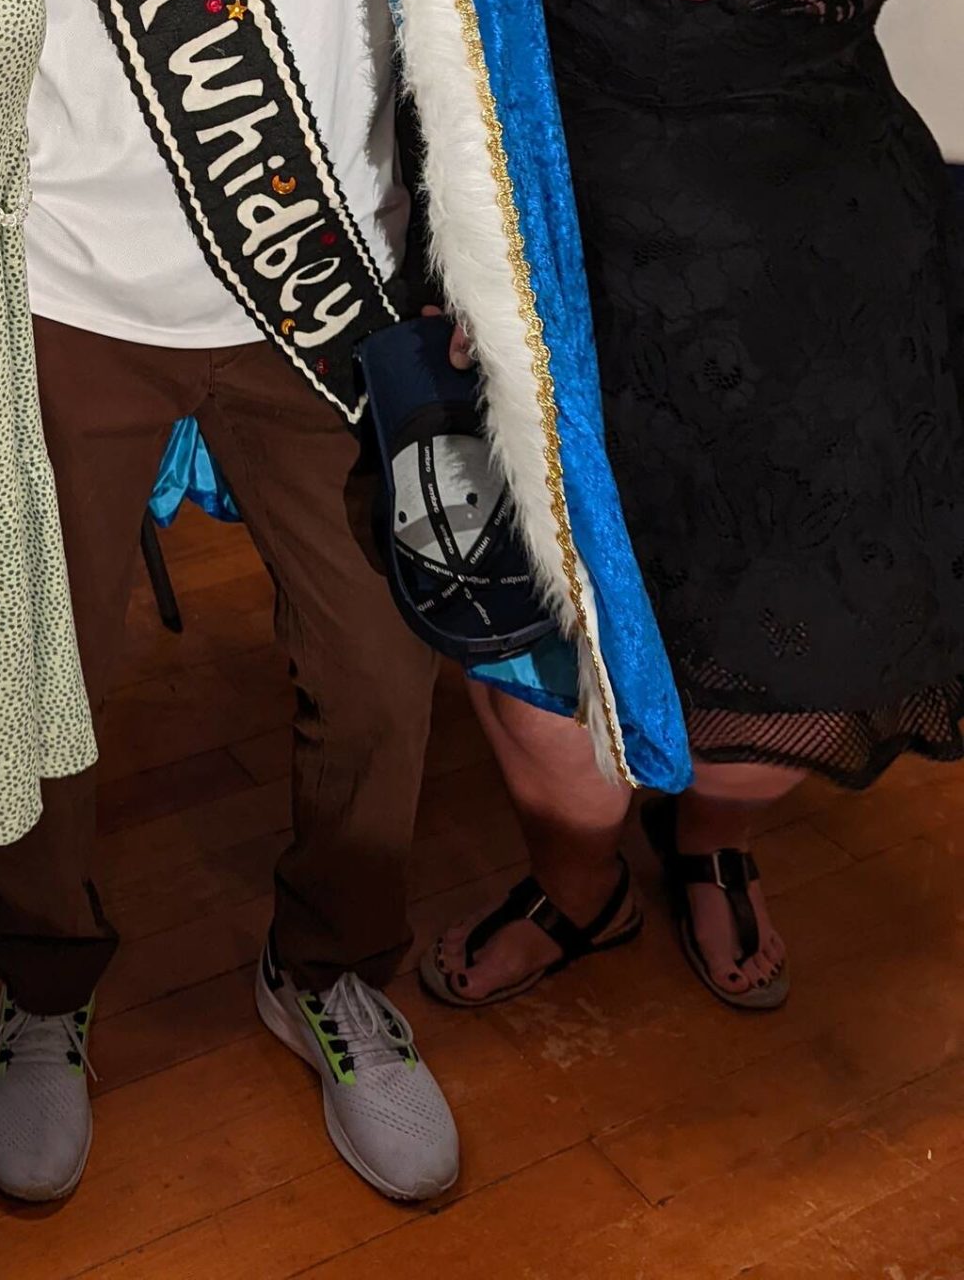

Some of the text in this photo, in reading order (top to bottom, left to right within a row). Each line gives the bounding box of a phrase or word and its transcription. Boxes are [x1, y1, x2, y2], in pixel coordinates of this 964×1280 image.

[426, 482, 440, 514] umbro
[469, 535, 491, 565] umbro
[423, 560, 454, 578] umbro
